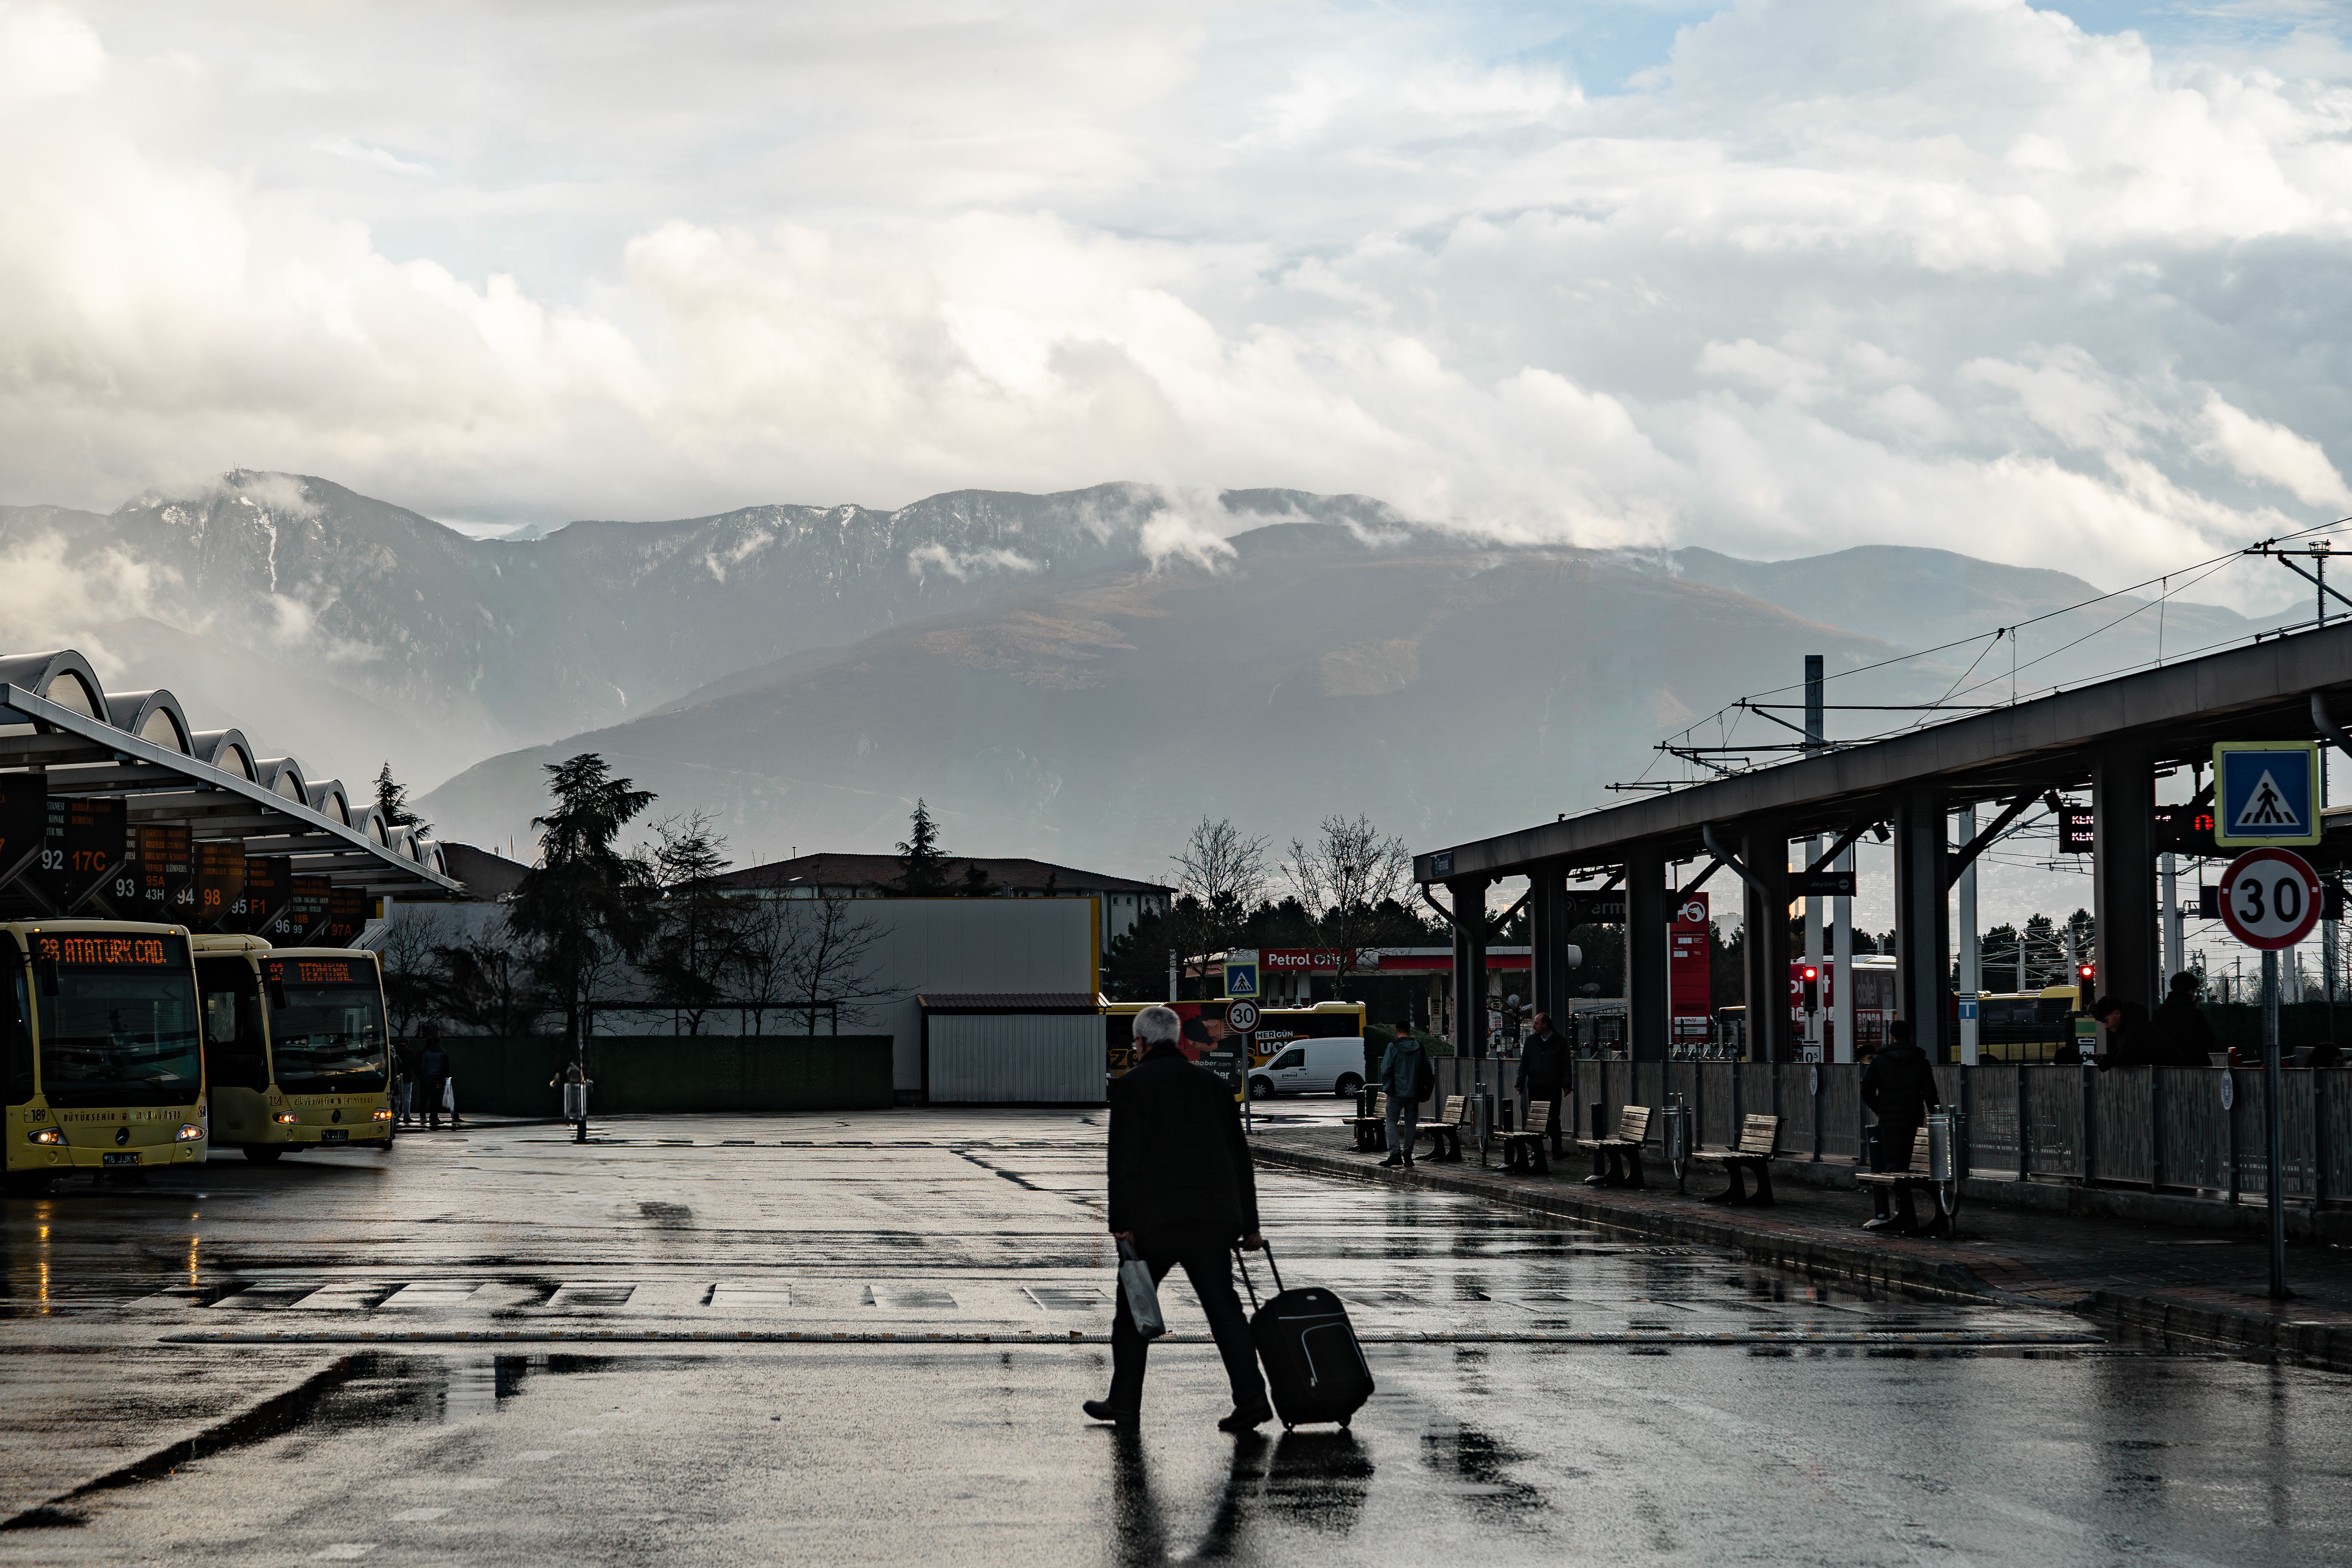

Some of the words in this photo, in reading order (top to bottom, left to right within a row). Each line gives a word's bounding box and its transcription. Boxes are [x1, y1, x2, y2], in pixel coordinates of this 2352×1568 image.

[49, 815, 64, 824] KONAK
[42, 850, 63, 870] 92
[72, 851, 106, 872] 17C
[146, 875, 165, 887] 95A
[116, 879, 134, 897] 93
[145, 889, 165, 900] 43H
[177, 888, 194, 905] 94
[204, 889, 220, 905] 98
[2239, 877, 2301, 924] 30
[231, 899, 247, 914] 95
[251, 899, 265, 914] F1
[294, 914, 309, 924] 18B
[275, 919, 290, 933] 96
[293, 925, 302, 933] 99
[331, 924, 352, 936] 97A
[1269, 953, 1310, 965] Petrol
[1233, 1008, 1253, 1024] 30
[31, 1109, 45, 1121] 189
[63, 1111, 115, 1123] BÜYÜKŞEHİR
[107, 1155, 115, 1163] 16
[118, 1155, 132, 1163] JJK
